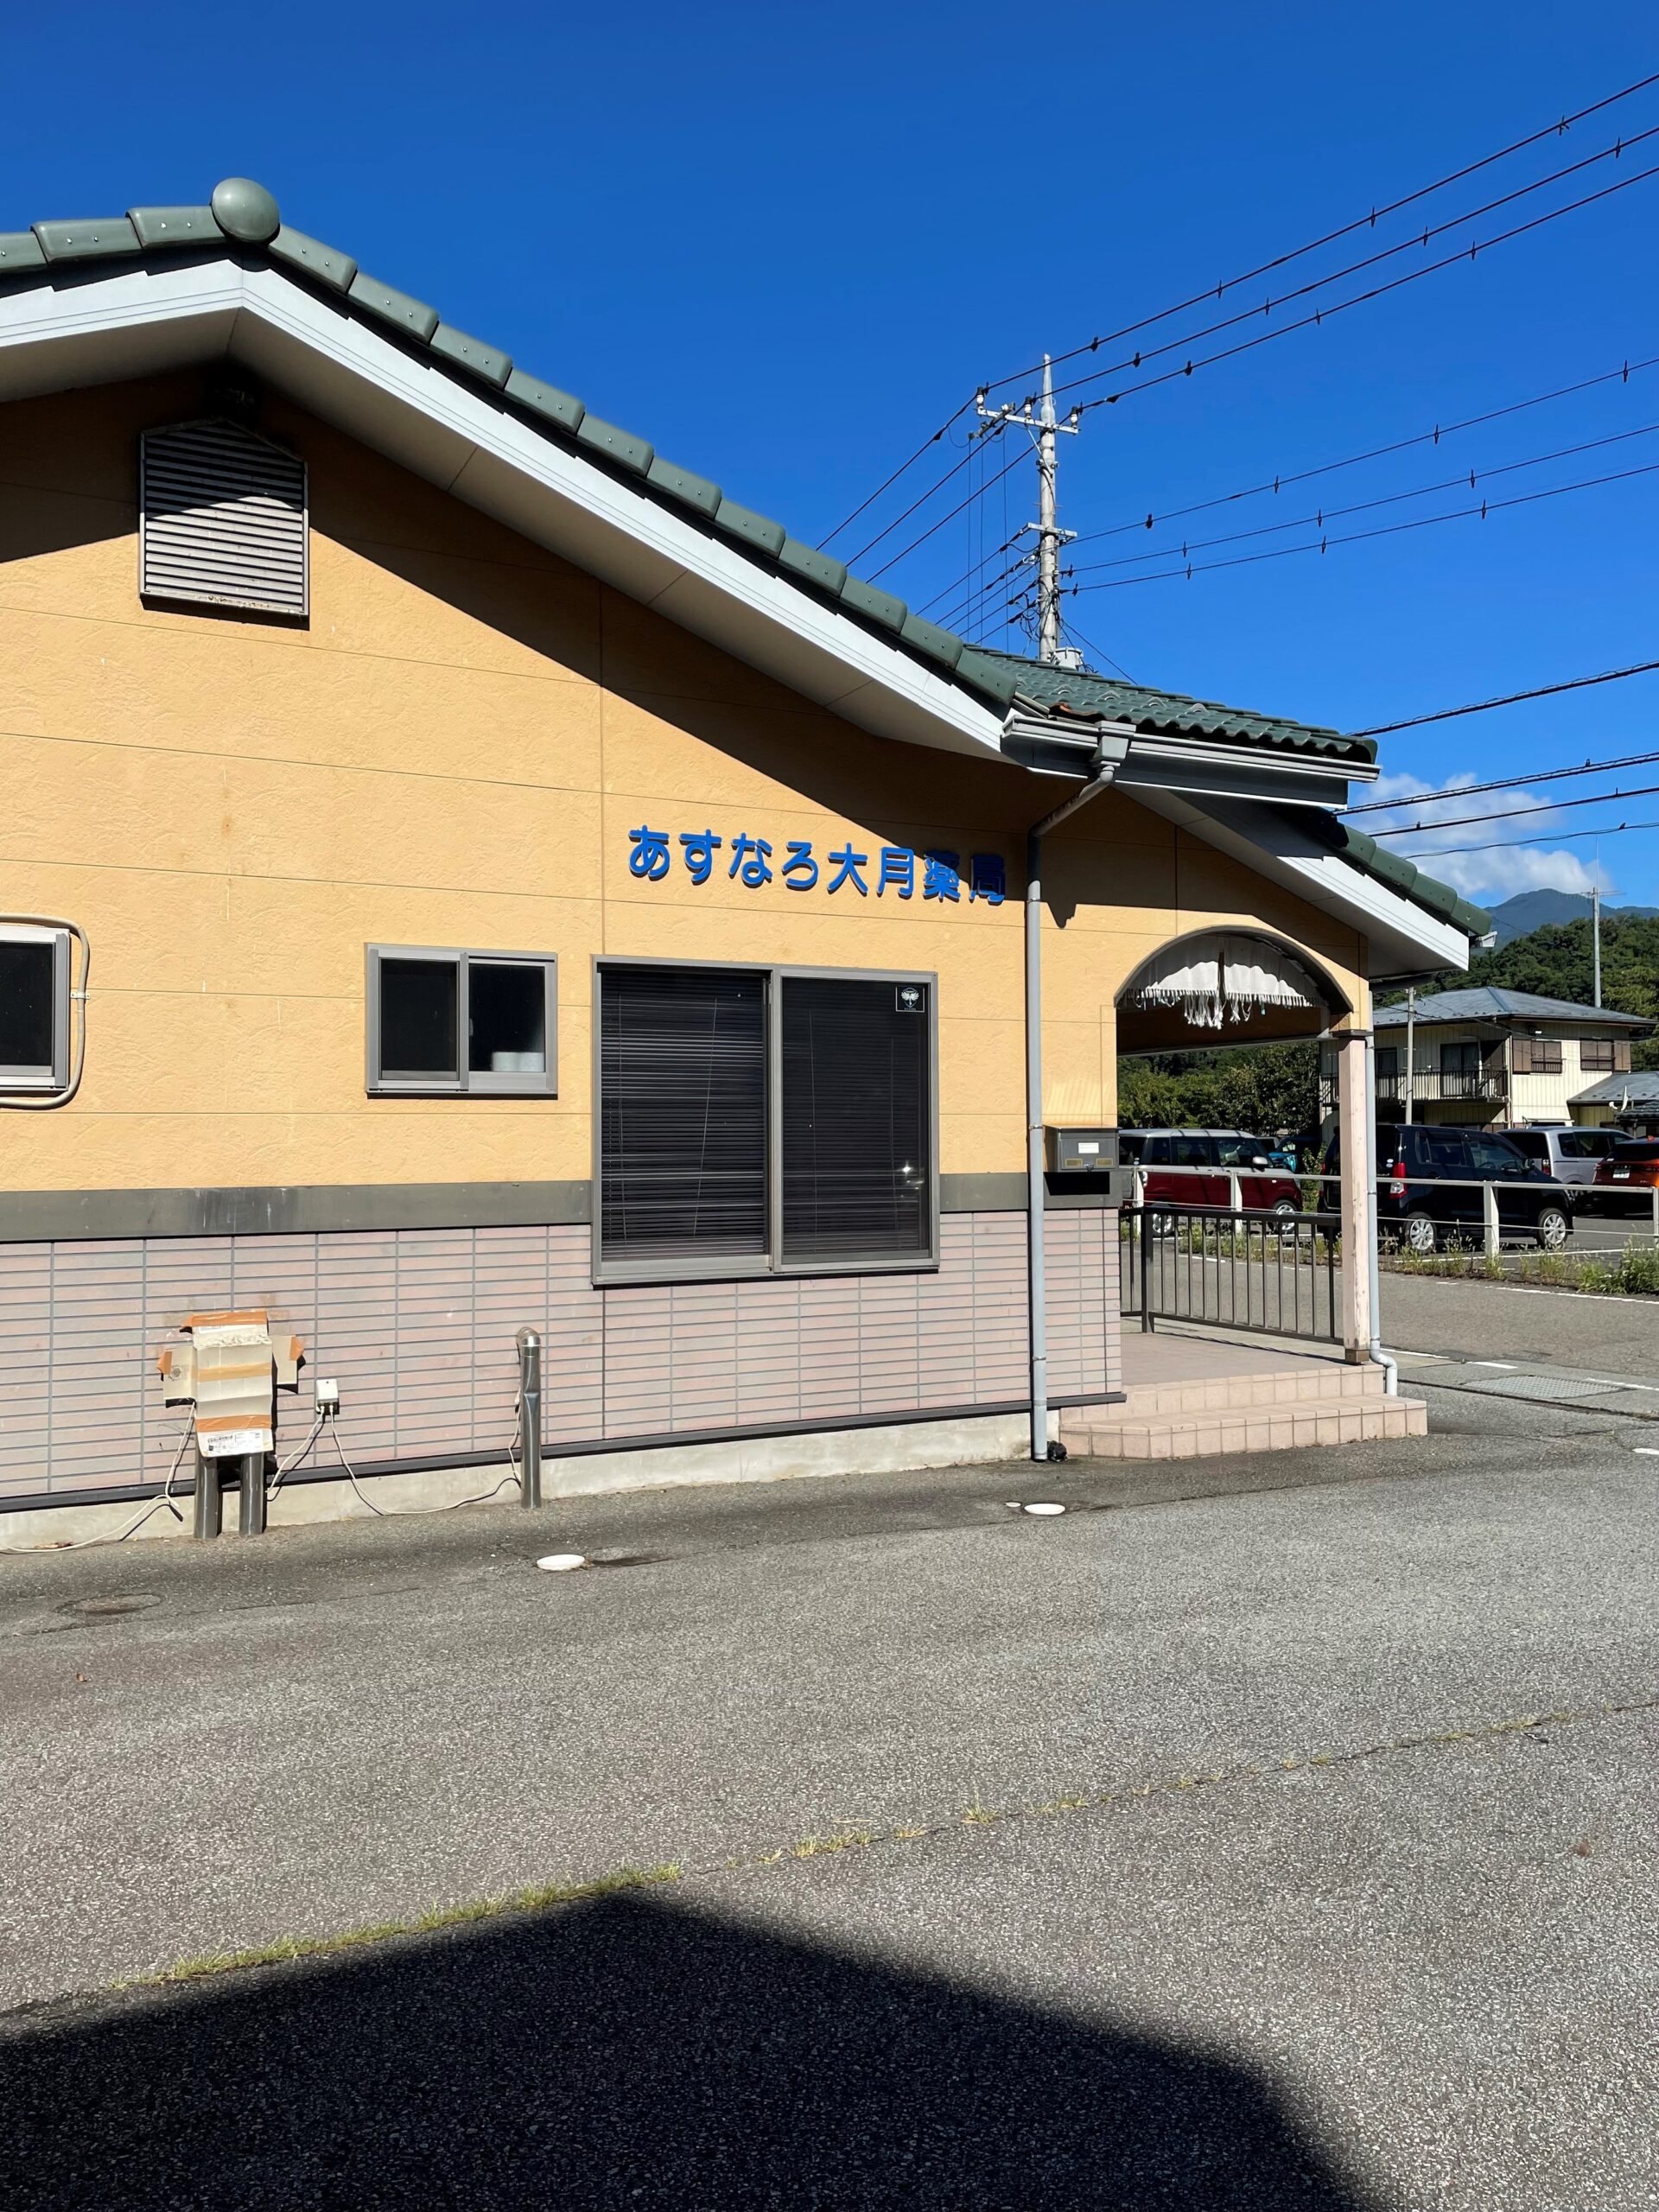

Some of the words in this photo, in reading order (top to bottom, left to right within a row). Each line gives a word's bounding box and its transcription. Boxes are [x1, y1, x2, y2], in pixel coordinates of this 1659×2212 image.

[628, 824, 1006, 906] あすなろ大月薬局
